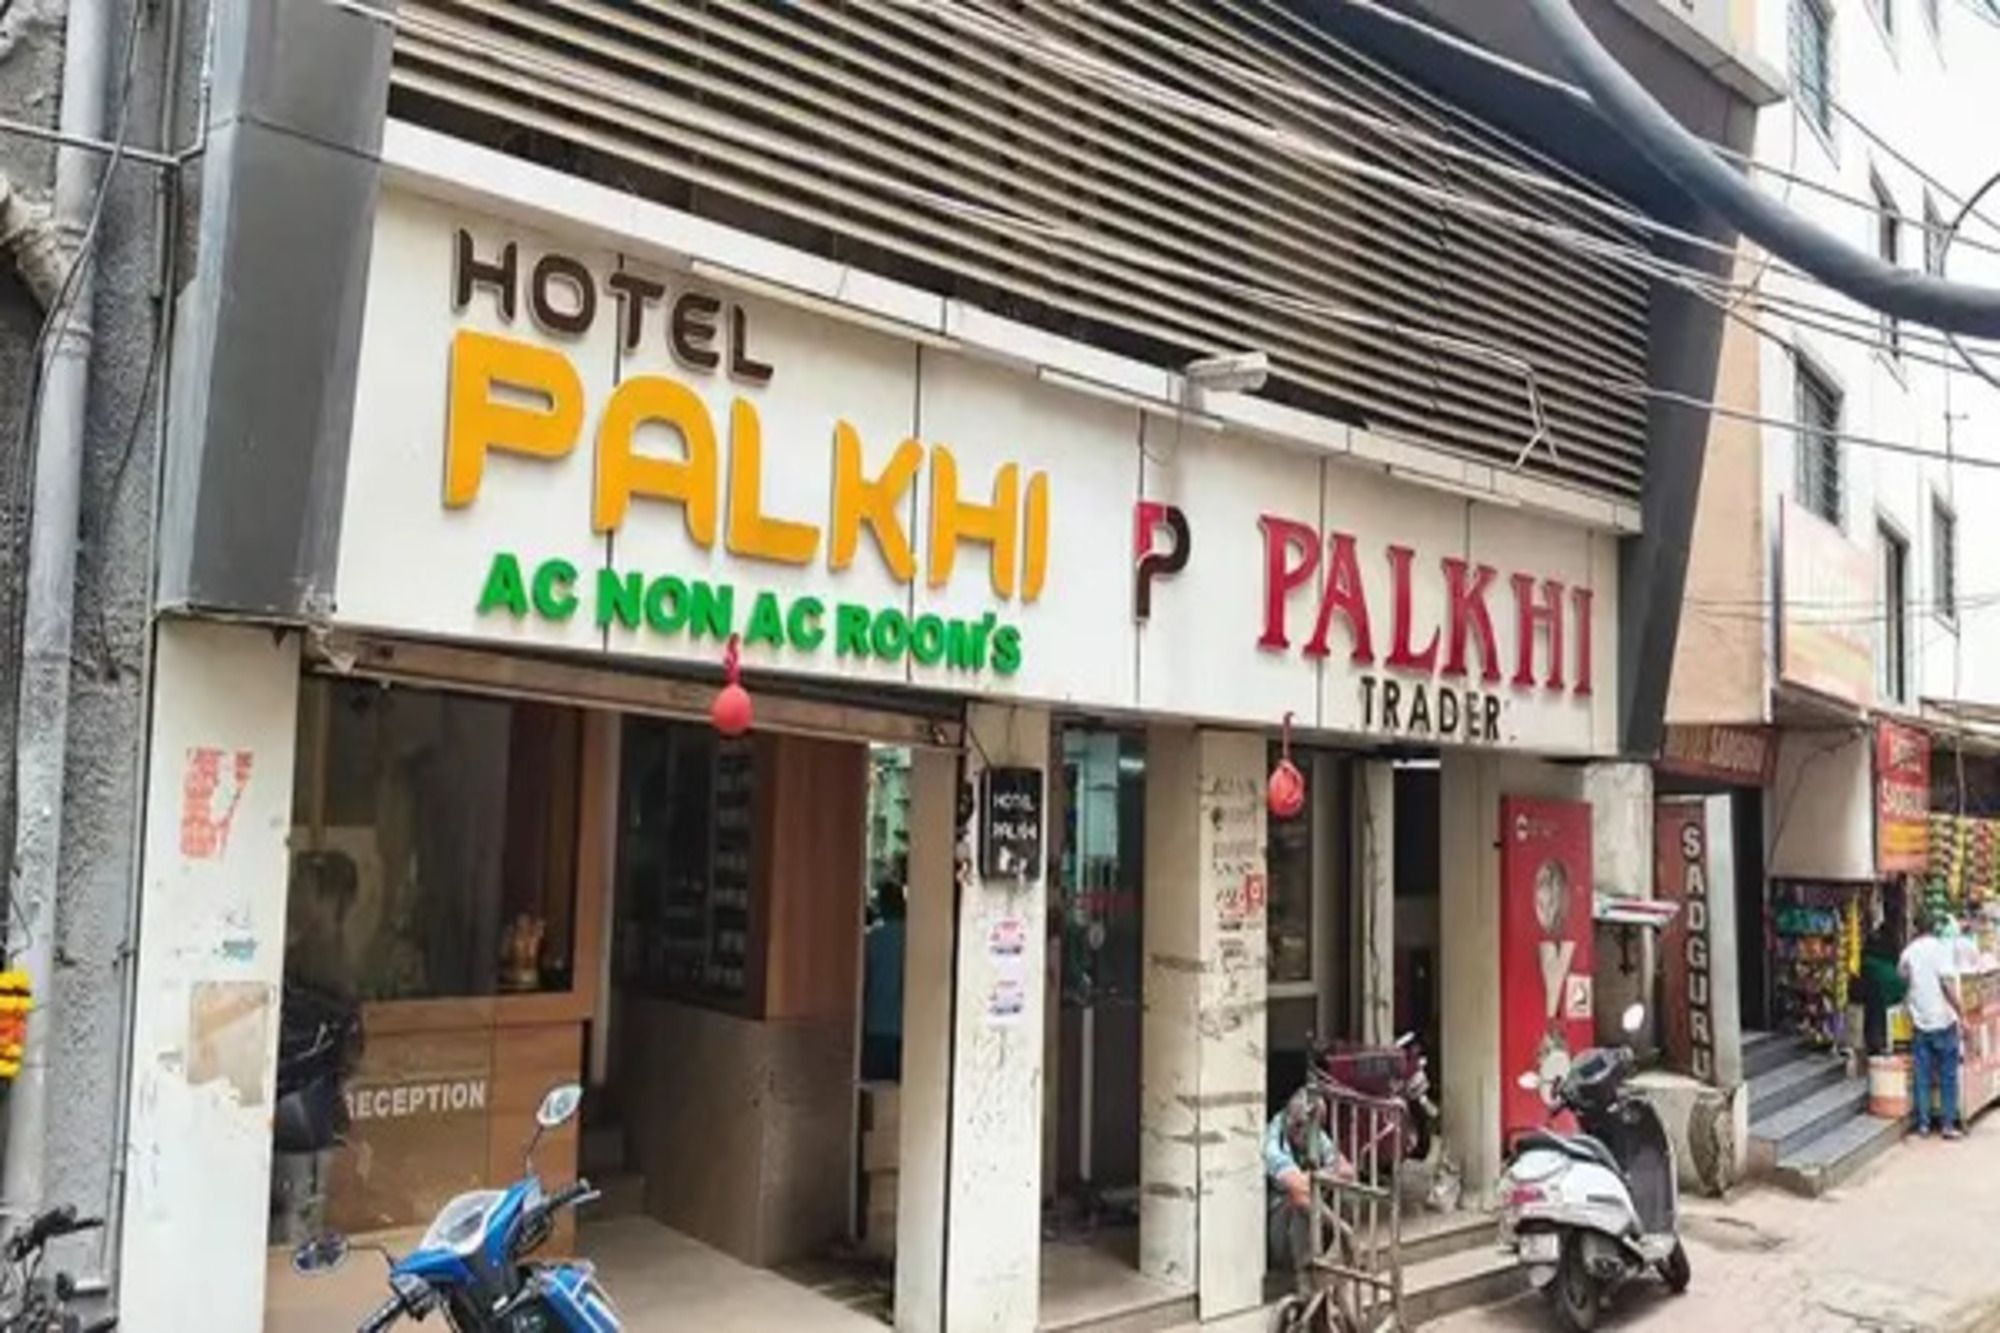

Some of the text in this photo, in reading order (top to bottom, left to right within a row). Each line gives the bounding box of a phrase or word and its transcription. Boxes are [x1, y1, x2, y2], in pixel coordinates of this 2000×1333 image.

[452, 228, 774, 386] HOTEL
[443, 330, 1049, 601] PALKHI
[478, 553, 579, 621] AC
[596, 568, 735, 641] NON
[743, 592, 826, 650] AC
[1258, 514, 1595, 696] PALKHI
[1360, 675, 1501, 741] TRADER
[1682, 826, 1711, 1080] SADGURU
